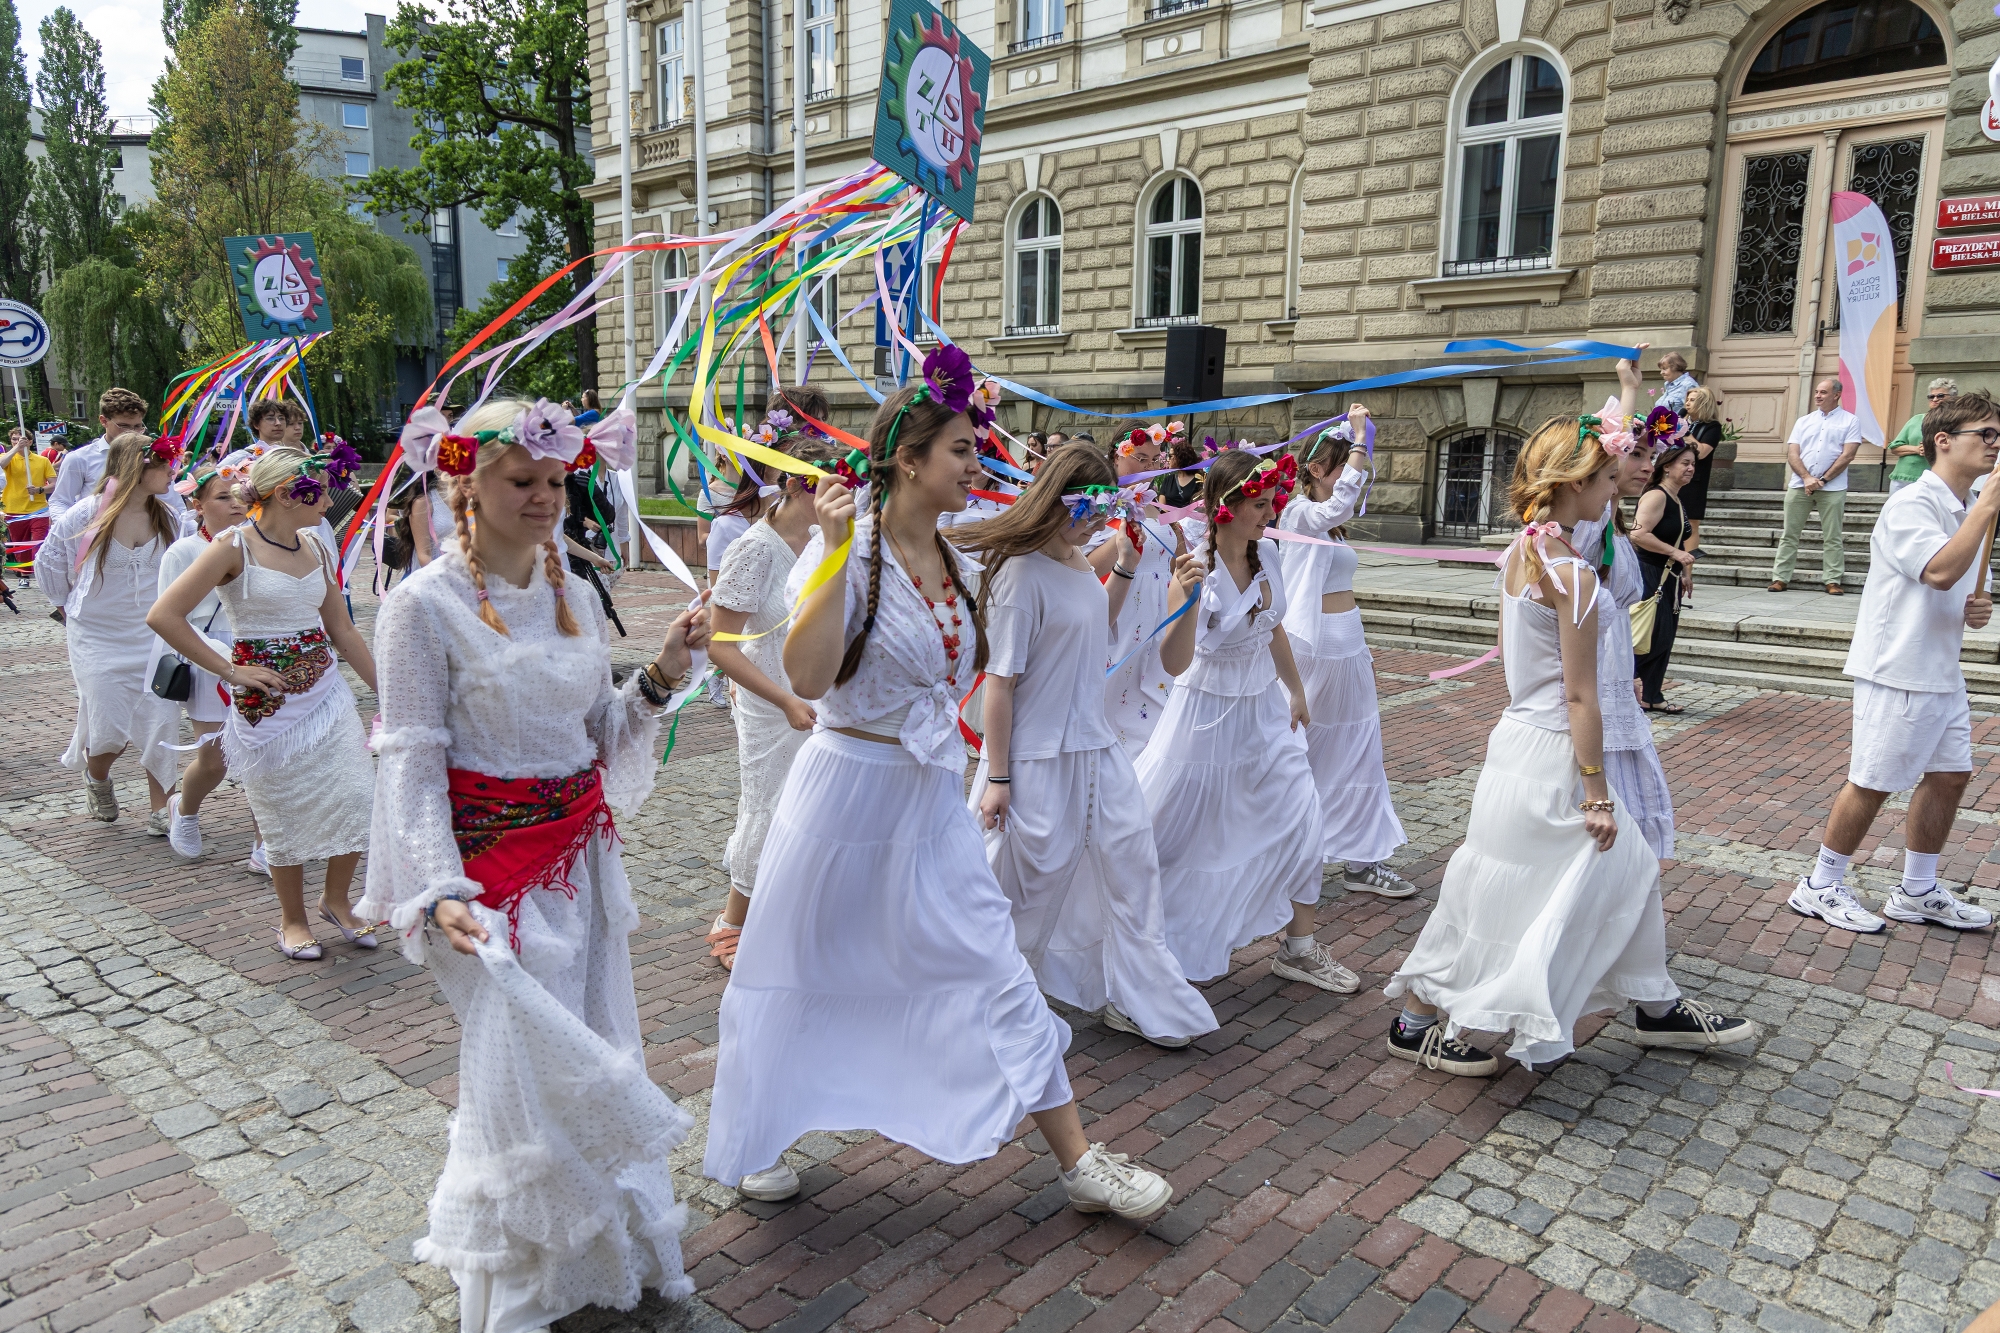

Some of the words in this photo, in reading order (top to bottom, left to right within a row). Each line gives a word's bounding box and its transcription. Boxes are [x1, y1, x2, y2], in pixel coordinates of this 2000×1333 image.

[1947, 203, 1981, 214] RADA
[1961, 211, 2000, 221] BIELSKU
[1939, 241, 2000, 254] PREZYDENT
[40, 423, 66, 433] TAXI
